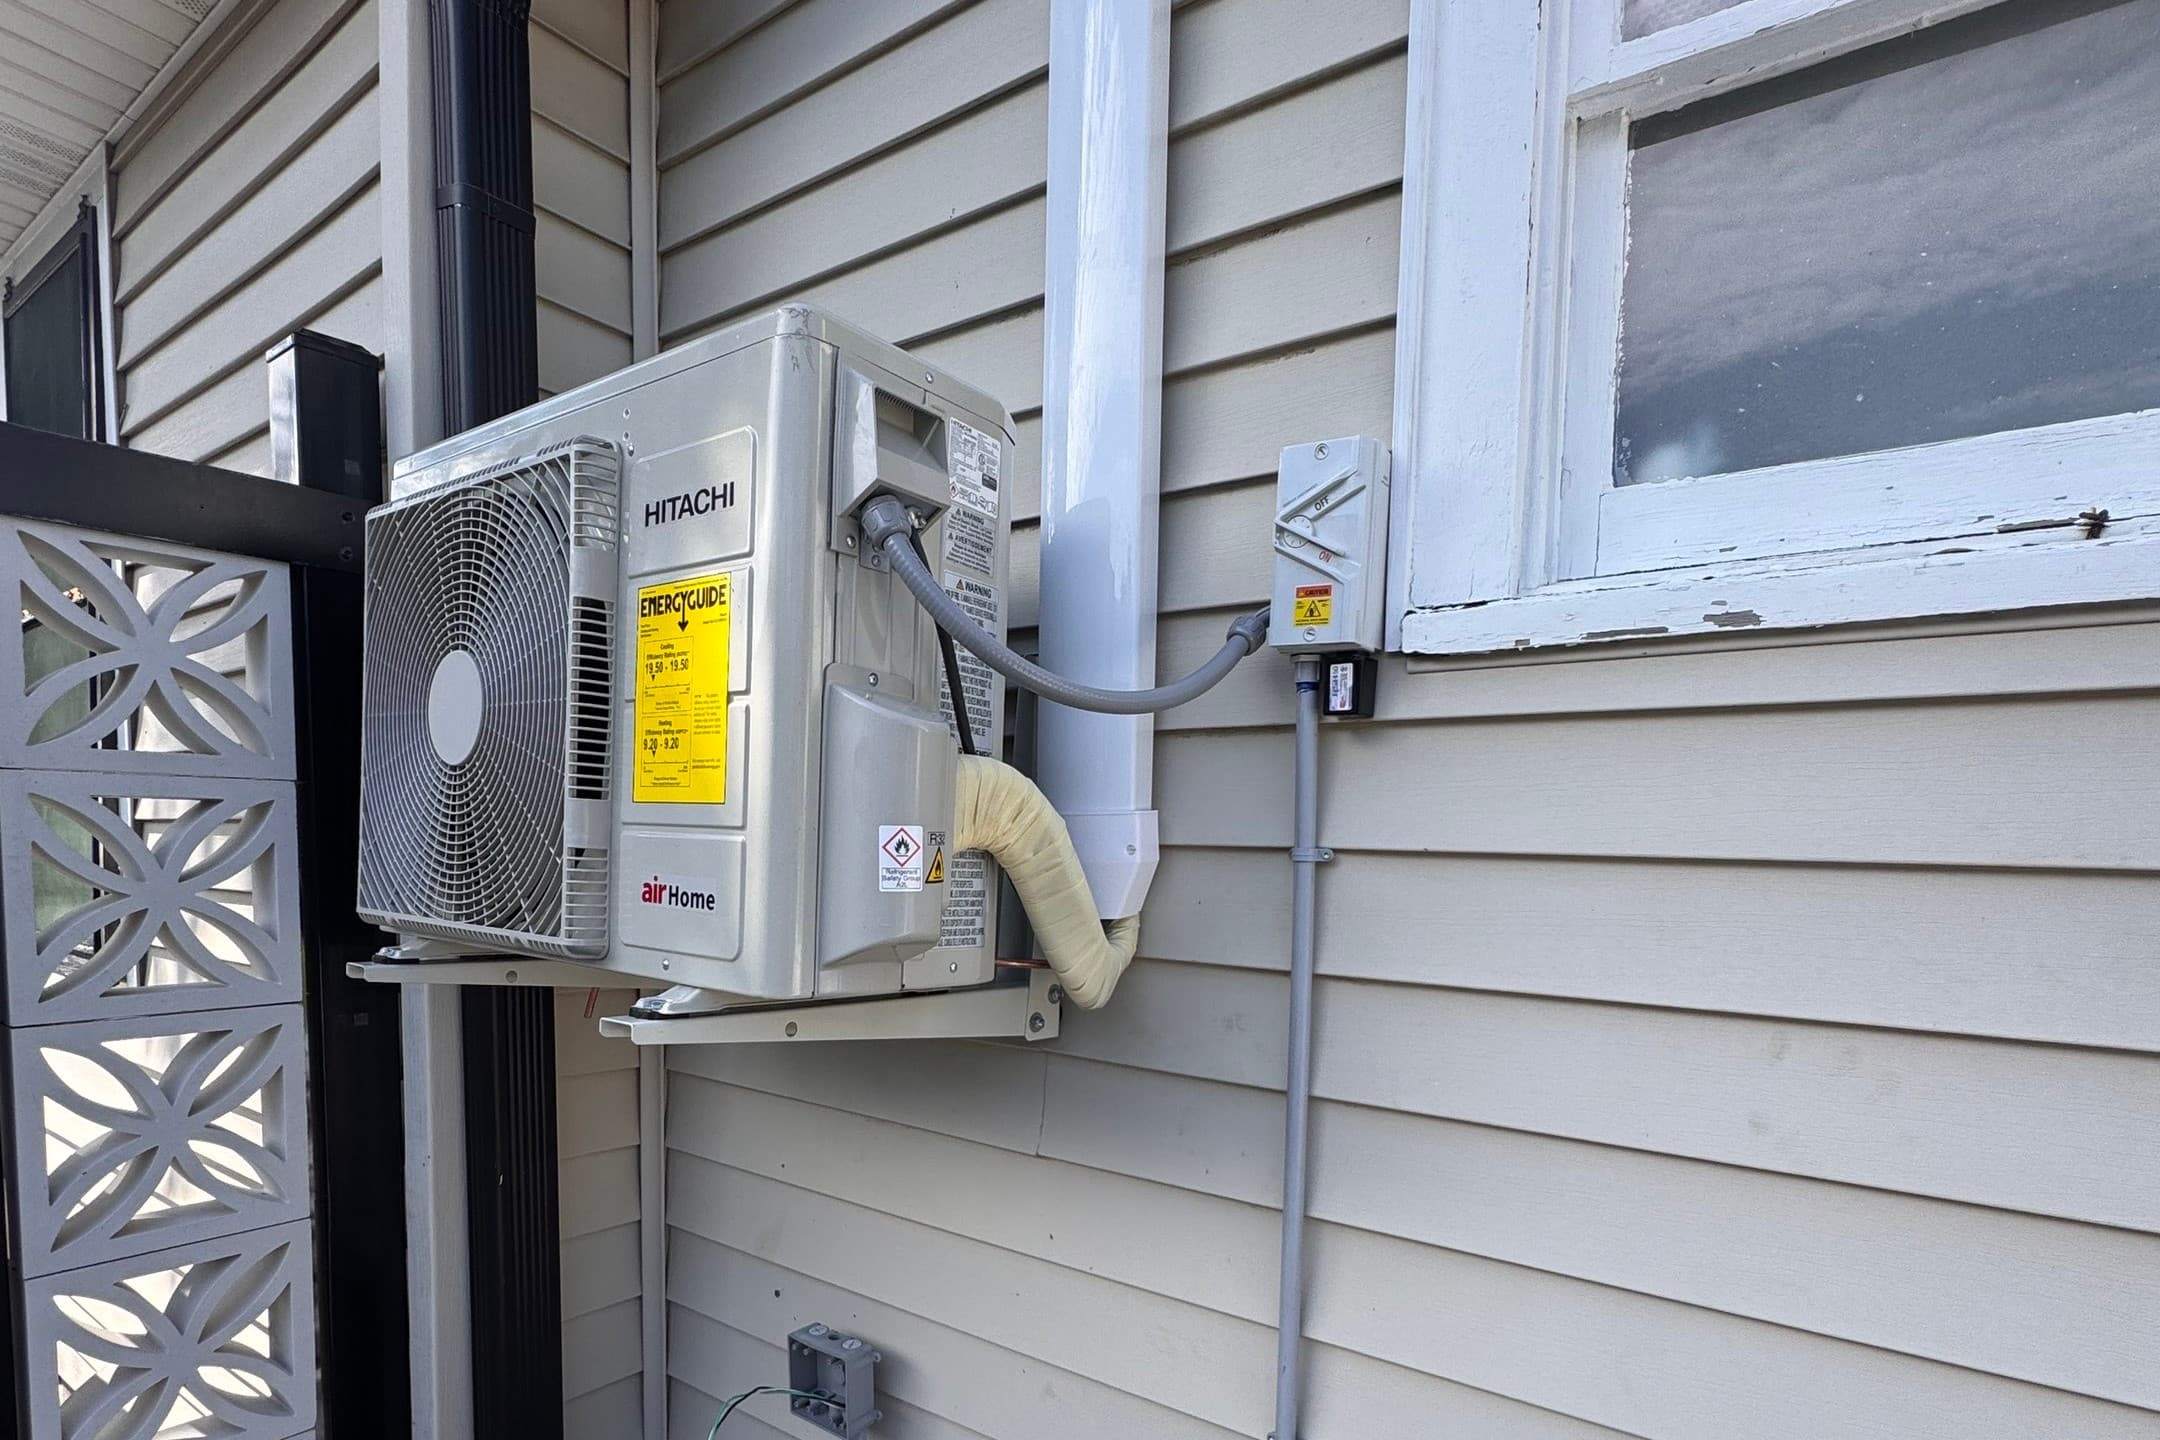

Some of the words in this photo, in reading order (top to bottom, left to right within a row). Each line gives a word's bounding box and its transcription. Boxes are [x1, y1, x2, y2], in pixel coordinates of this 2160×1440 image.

[645, 481, 735, 527] HITACHI
[1314, 495, 1330, 512] OFF
[1318, 551, 1332, 563] ON
[965, 580, 992, 599] WARNING
[640, 584, 727, 618] ENERGYGUIDE
[645, 661, 664, 675] 19.50
[670, 658, 689, 672] 19.50
[643, 738, 658, 751] 9.20
[664, 737, 680, 750] 9.20
